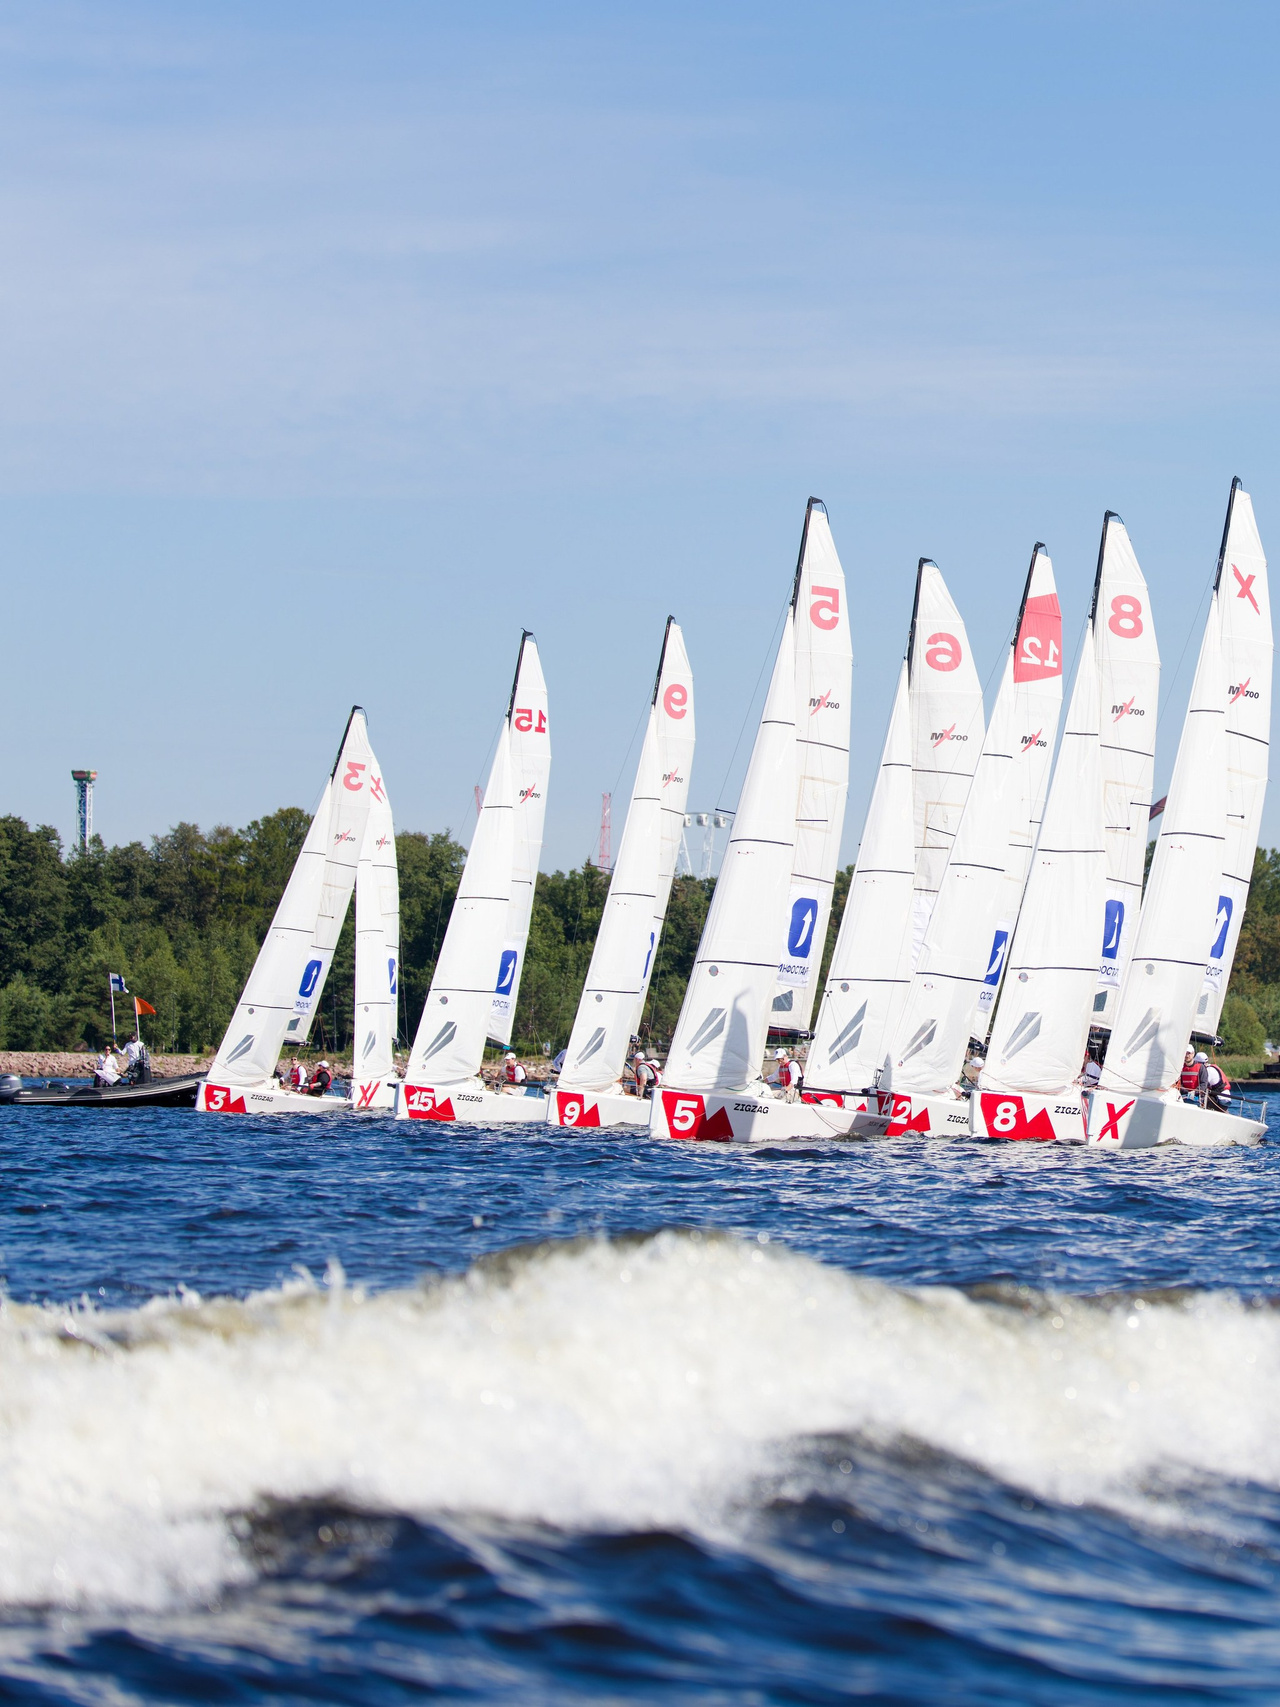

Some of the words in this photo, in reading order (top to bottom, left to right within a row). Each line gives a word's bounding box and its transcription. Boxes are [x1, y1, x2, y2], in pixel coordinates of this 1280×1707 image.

[808, 688, 840, 717] MX700
[1228, 676, 1260, 705] MX700
[1111, 696, 1145, 723] MX700
[930, 722, 969, 749] MX700
[208, 1089, 228, 1110] 3
[250, 1093, 275, 1103] ZIGZAG
[407, 1090, 435, 1111] 15
[456, 1093, 484, 1103] ZIGZAG
[733, 1102, 770, 1115] ZIGZAG
[563, 1100, 581, 1125] 9
[672, 1099, 698, 1131] 5
[946, 1114, 970, 1125] ZIGZA
[993, 1101, 1017, 1132] 8
[1096, 1099, 1136, 1142] X
